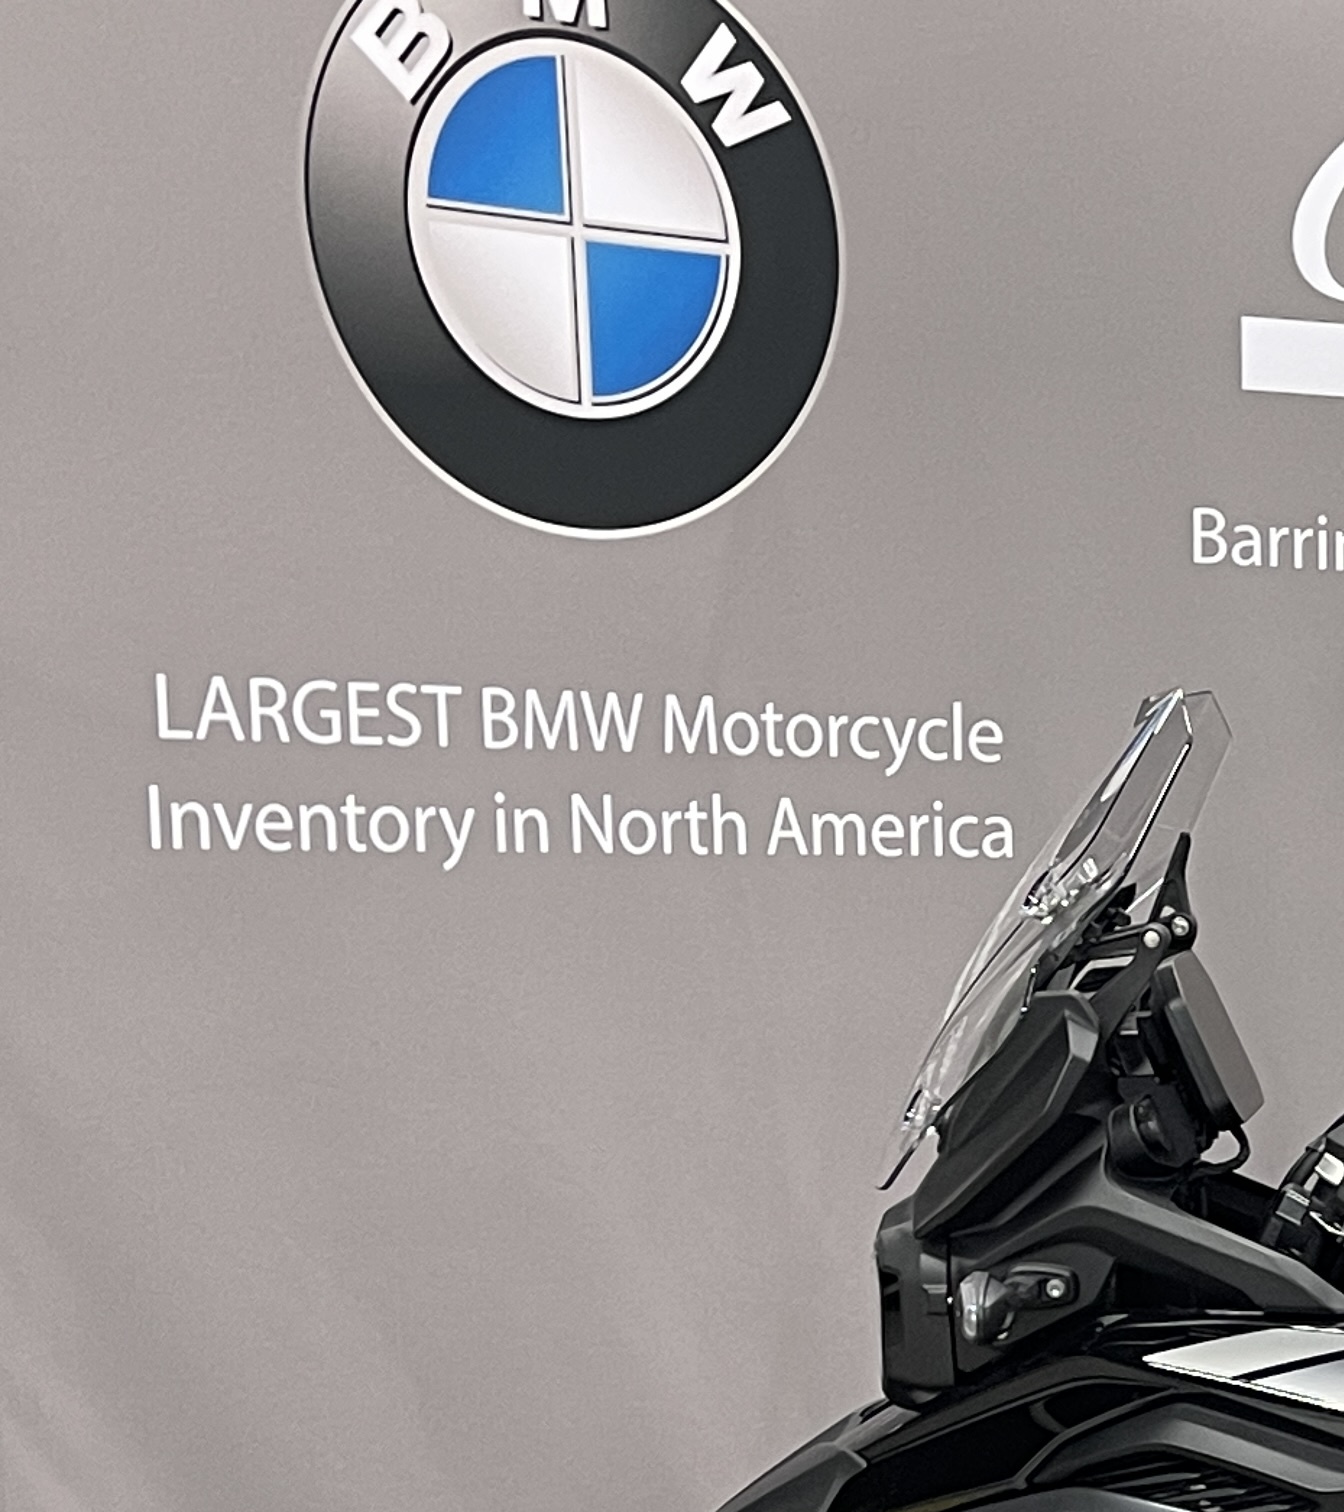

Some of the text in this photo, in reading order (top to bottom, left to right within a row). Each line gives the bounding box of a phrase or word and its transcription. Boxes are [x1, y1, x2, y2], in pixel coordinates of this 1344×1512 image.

[155, 672, 1005, 777] LARGEST BMW Motorcycle
[148, 784, 1014, 872] Inventory in North America
